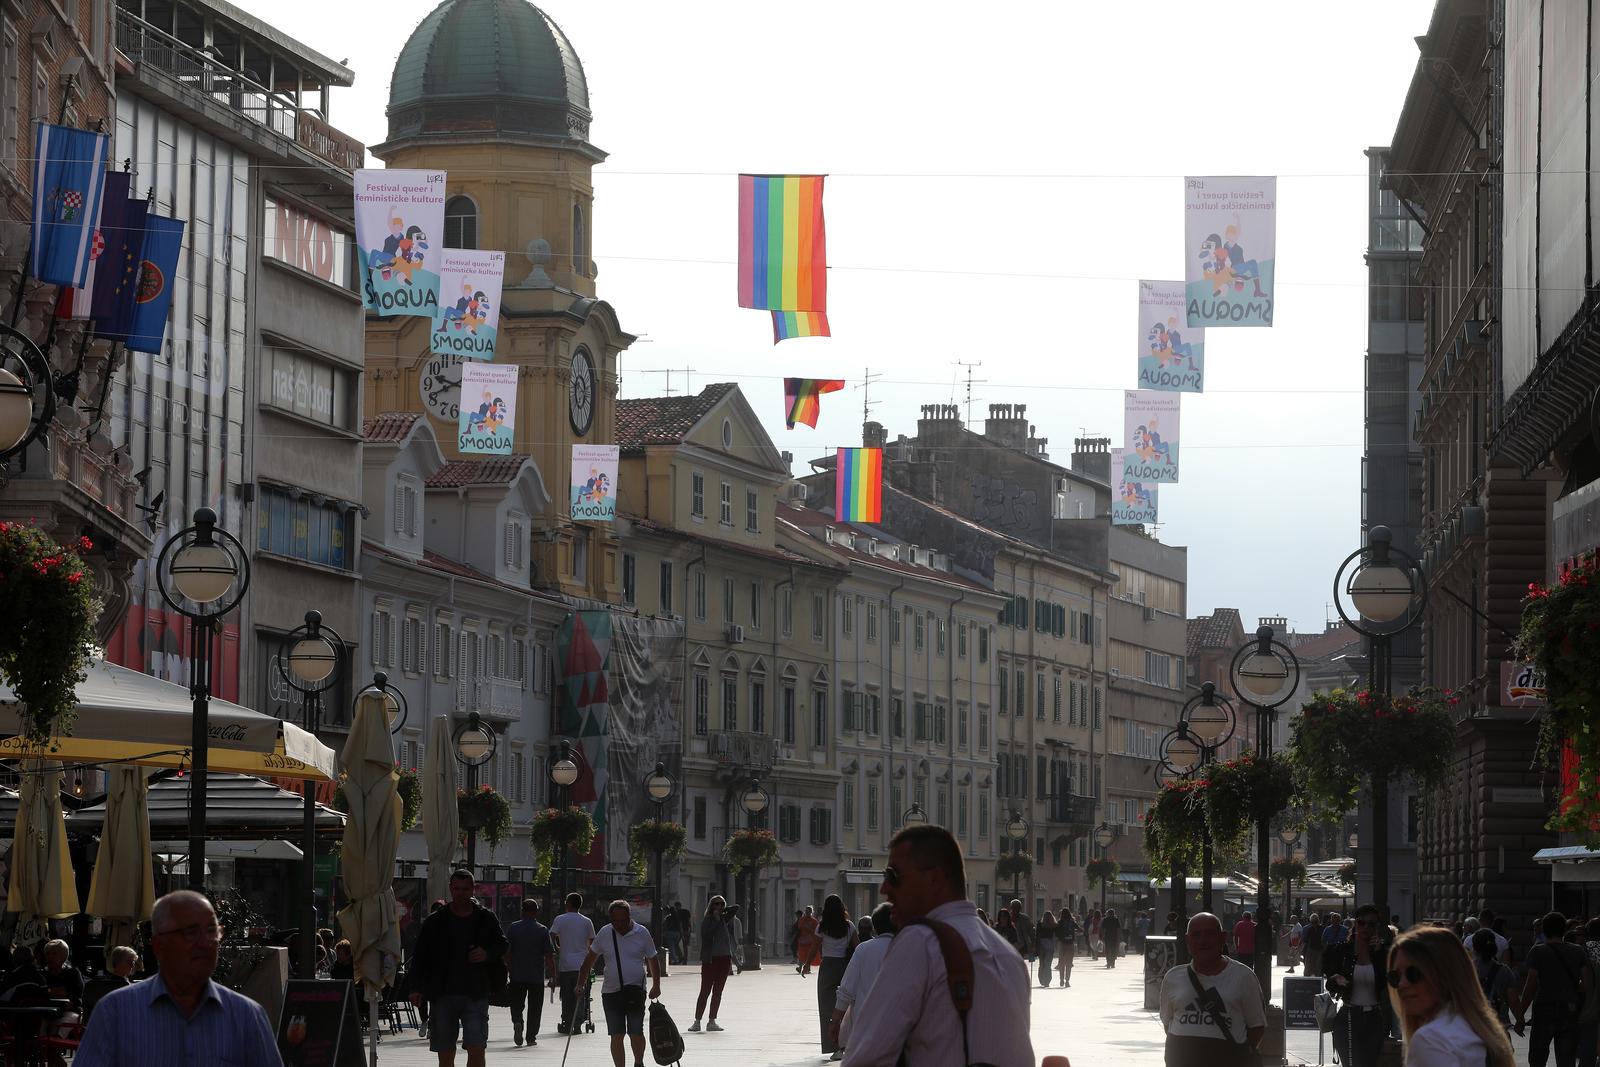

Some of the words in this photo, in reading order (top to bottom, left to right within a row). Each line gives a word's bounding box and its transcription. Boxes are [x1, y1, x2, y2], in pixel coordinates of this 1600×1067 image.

[366, 184, 400, 192] Festival
[402, 186, 428, 194] queer
[355, 193, 409, 203] feminističke
[411, 195, 444, 204] kulture
[275, 199, 334, 283] NKD
[445, 259, 471, 267] Festival
[471, 261, 492, 269] queer
[478, 268, 503, 276] kulture
[433, 333, 494, 353] SMOQUA
[441, 353, 449, 368] 11
[429, 361, 440, 375] 10
[424, 377, 433, 391] 9
[428, 391, 438, 406] 8
[440, 401, 449, 415] 7
[450, 404, 459, 419] 6
[460, 435, 512, 450] SMOQUA
[572, 505, 615, 518] SMOQUA
